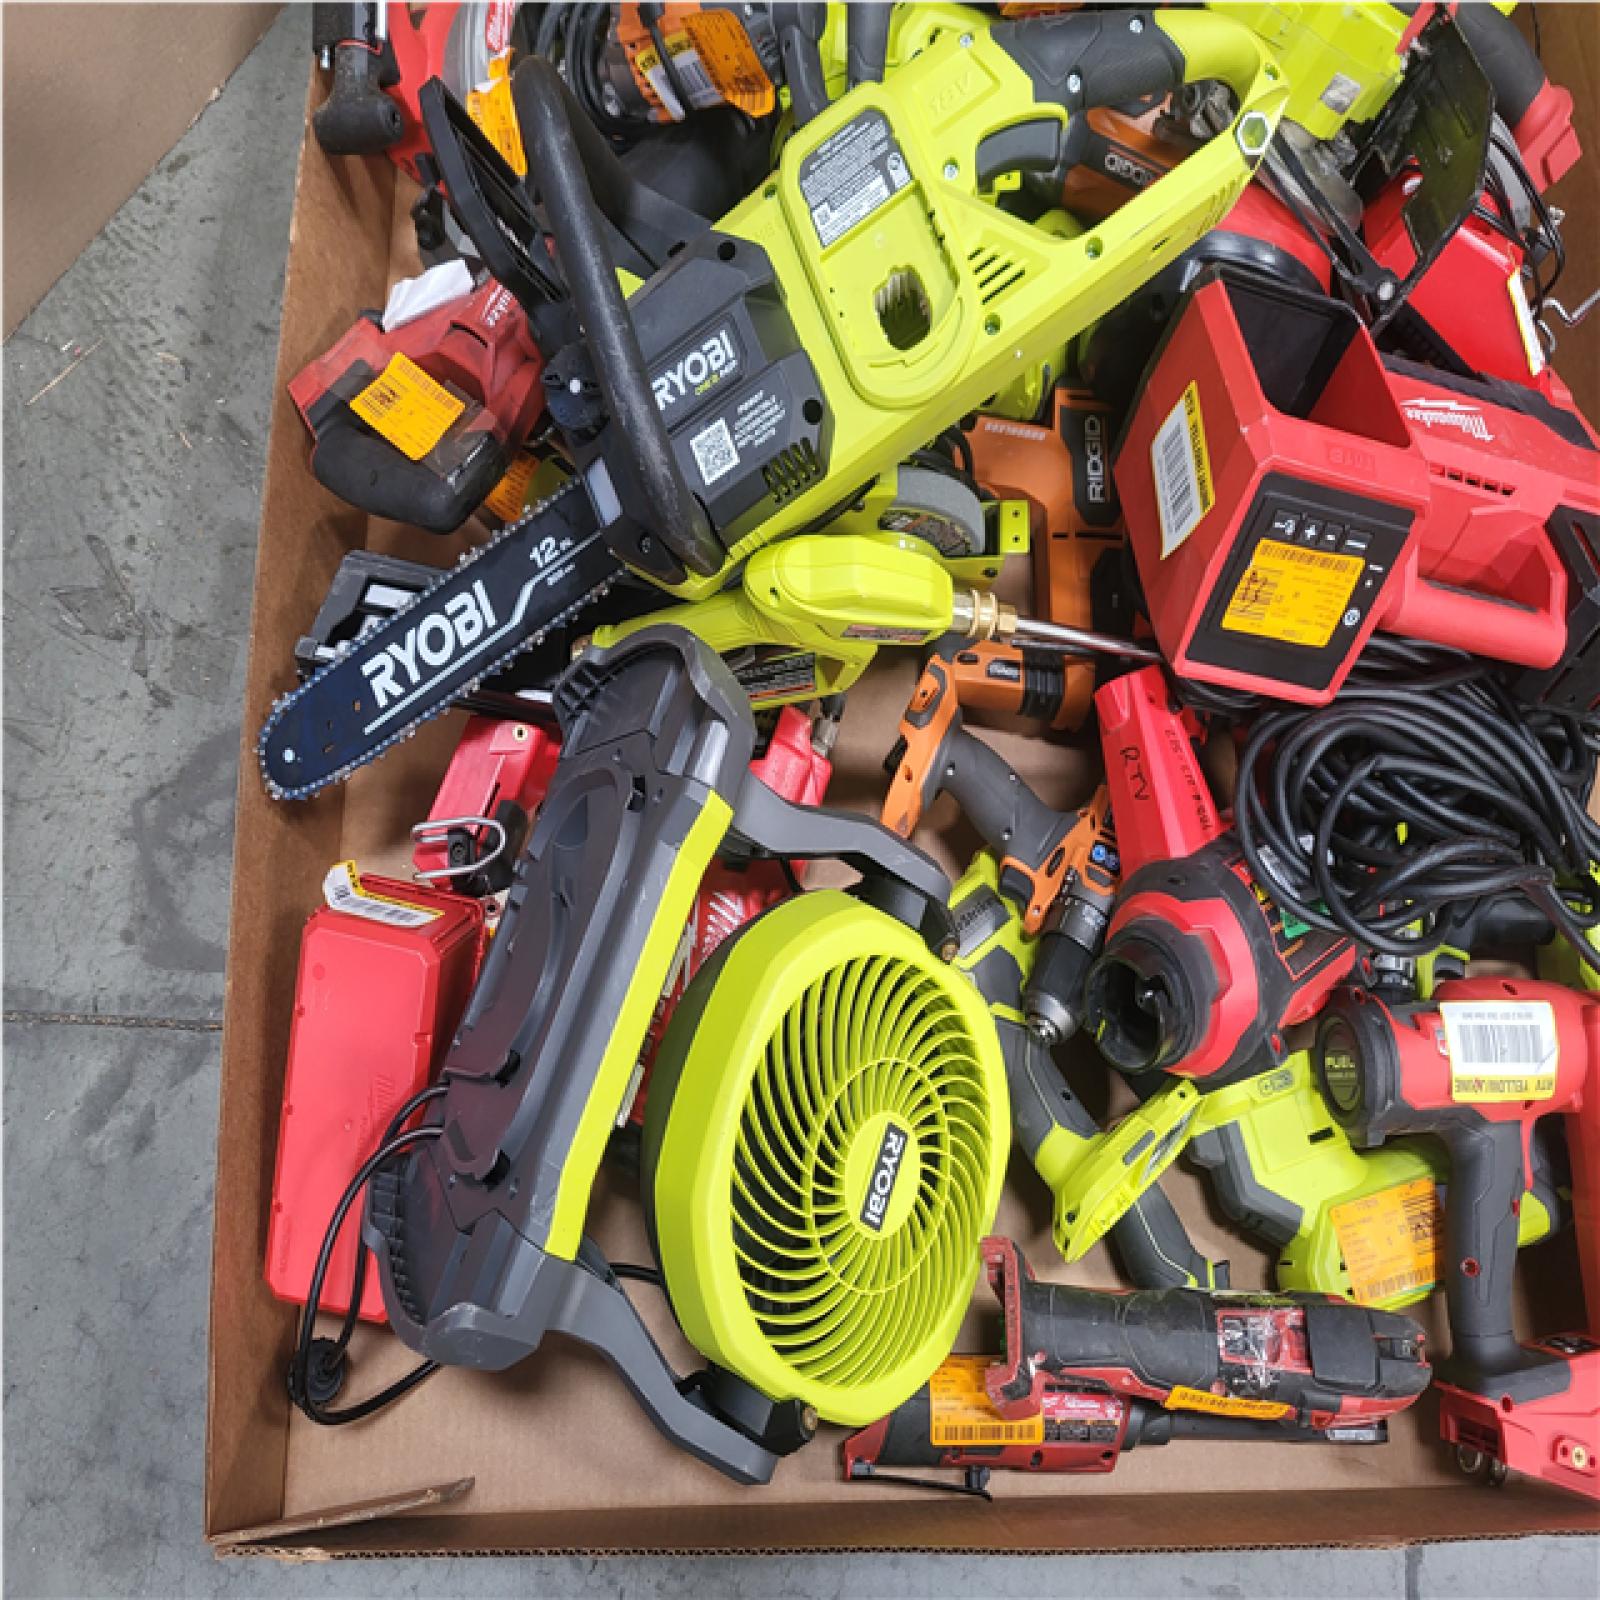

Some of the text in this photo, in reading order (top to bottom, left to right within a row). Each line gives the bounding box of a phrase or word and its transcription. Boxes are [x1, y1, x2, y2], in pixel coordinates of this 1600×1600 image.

[651, 330, 737, 412] RYOBI
[1084, 414, 1106, 503] RIDGID
[529, 536, 560, 570] 12
[361, 580, 500, 708] RYOBI
[864, 1131, 906, 1224] RYOBI
